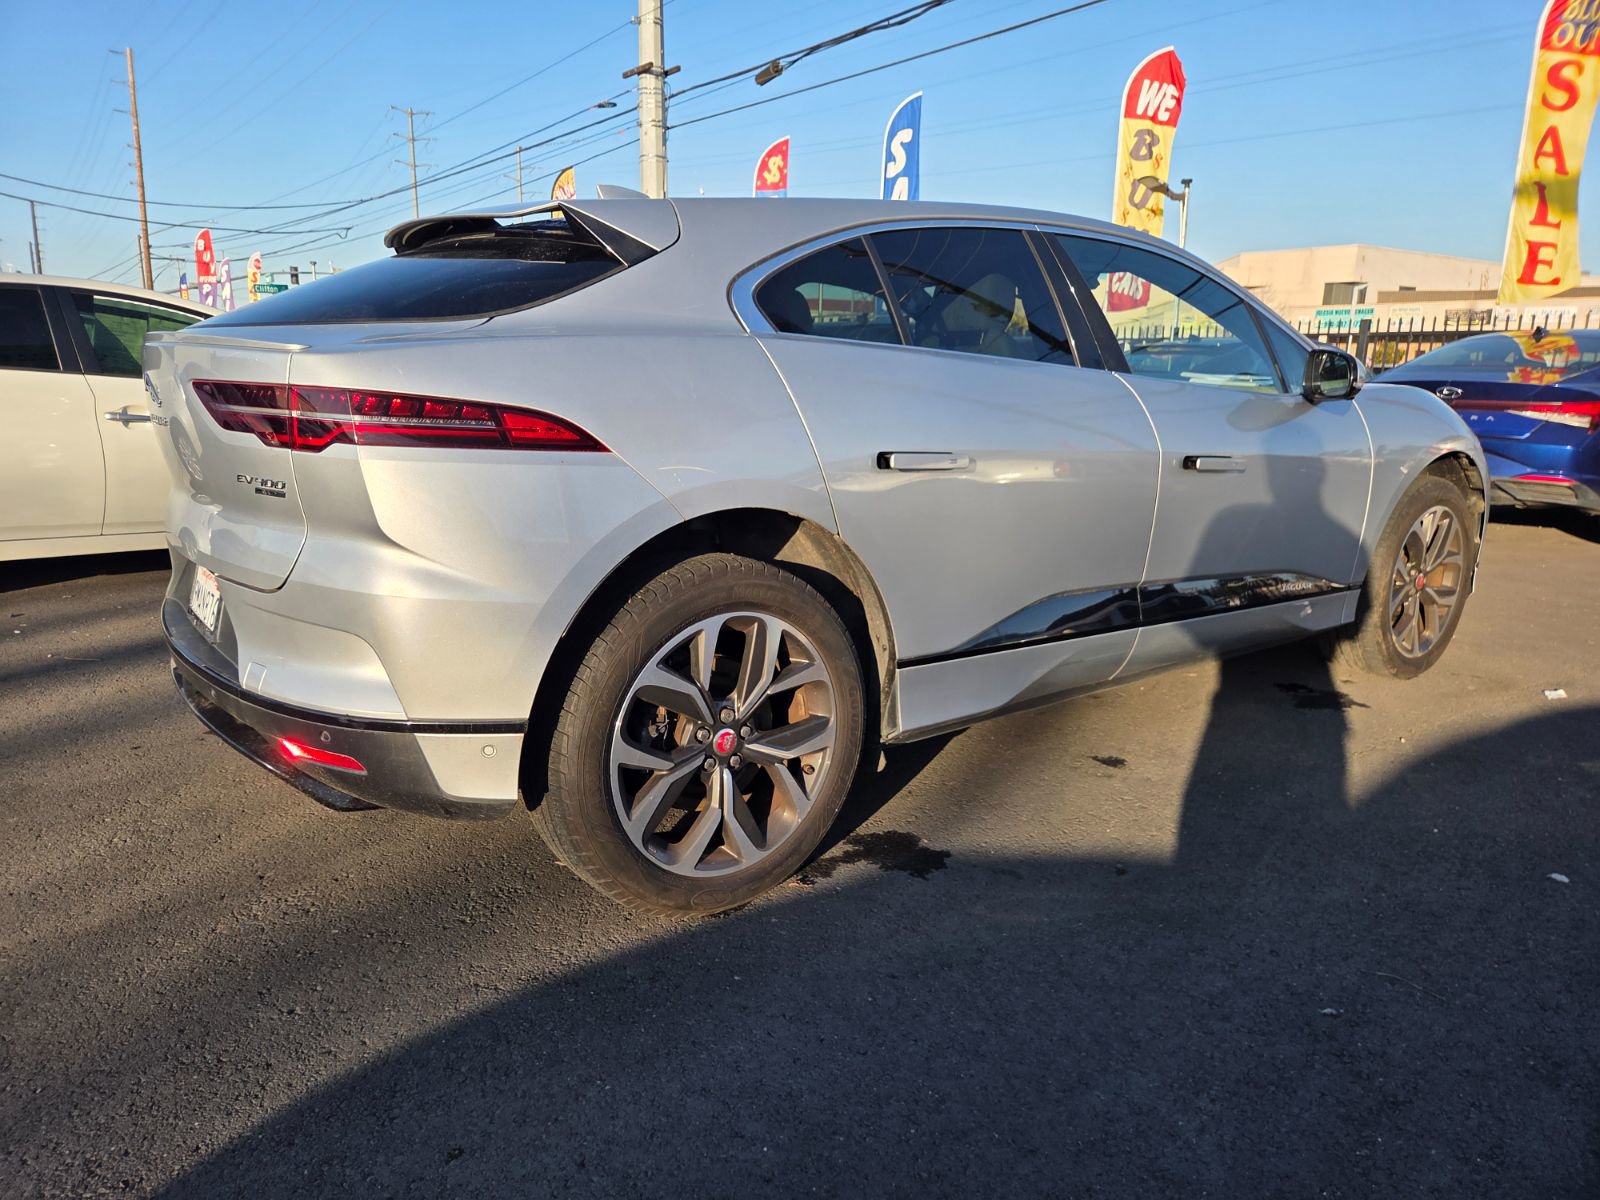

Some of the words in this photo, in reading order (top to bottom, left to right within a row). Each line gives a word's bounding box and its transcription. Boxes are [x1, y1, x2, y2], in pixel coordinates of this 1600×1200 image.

[1136, 79, 1179, 122] WE
[1516, 58, 1585, 286] SALE
[197, 239, 216, 274] BUY
